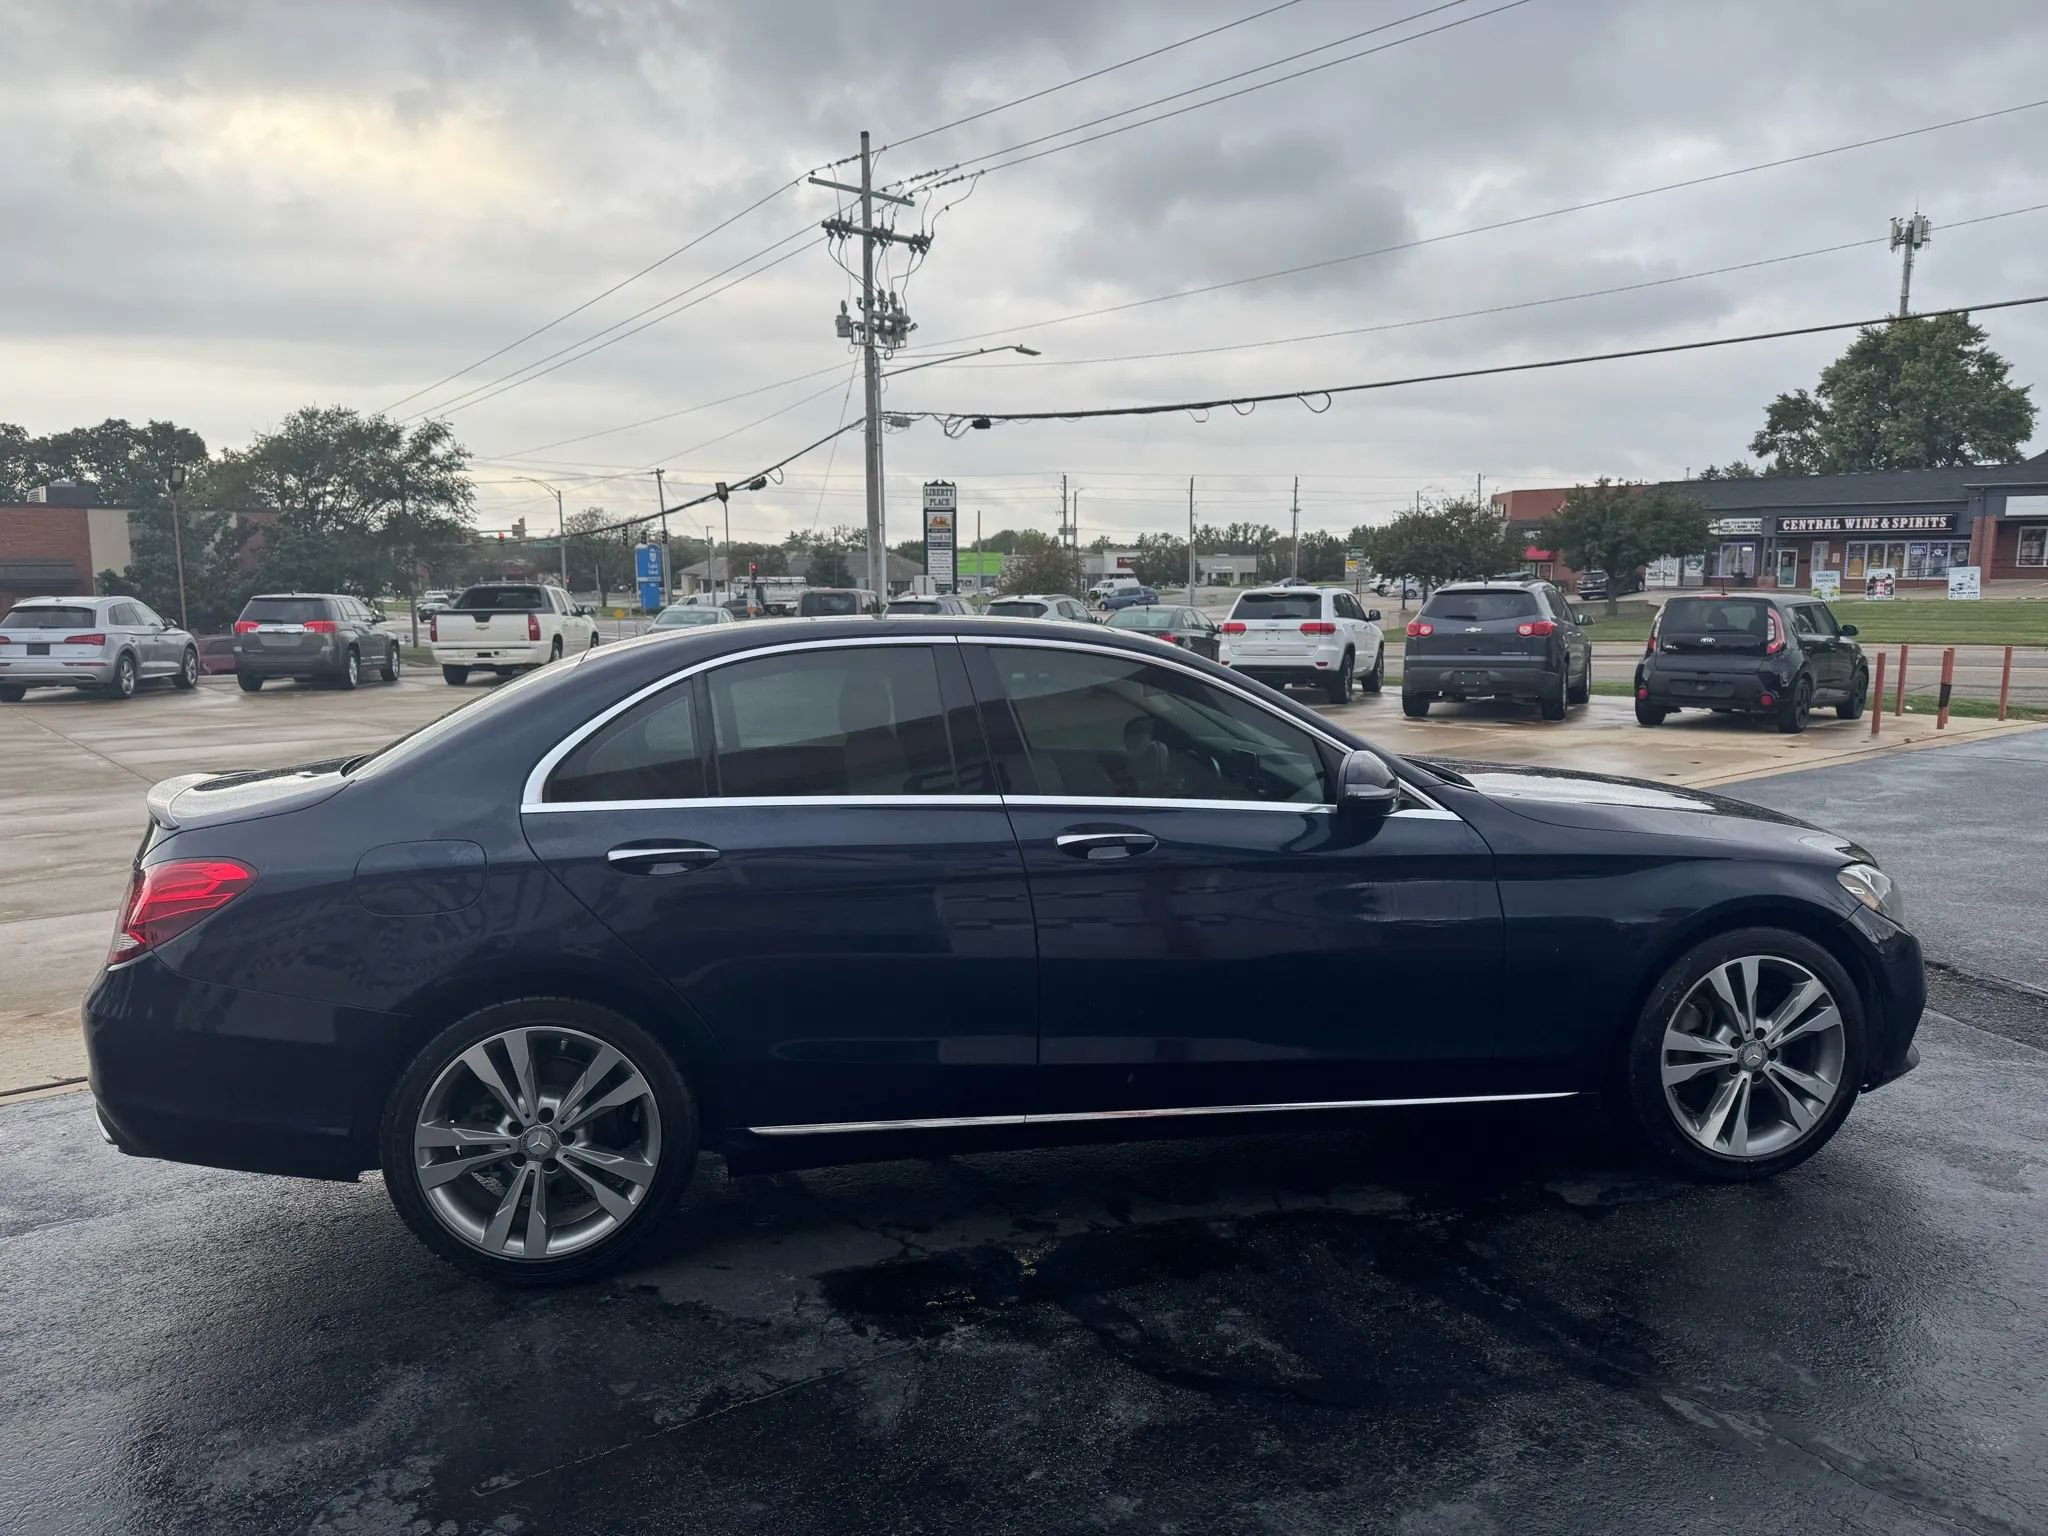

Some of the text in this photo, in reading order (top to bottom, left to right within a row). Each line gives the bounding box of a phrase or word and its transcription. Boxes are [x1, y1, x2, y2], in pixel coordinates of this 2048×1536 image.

[925, 488, 953, 496] LIBERTY
[1782, 519, 1840, 530] CENTRAL
[1844, 518, 1879, 529] WINE
[1891, 517, 1947, 528] SPIRITS
